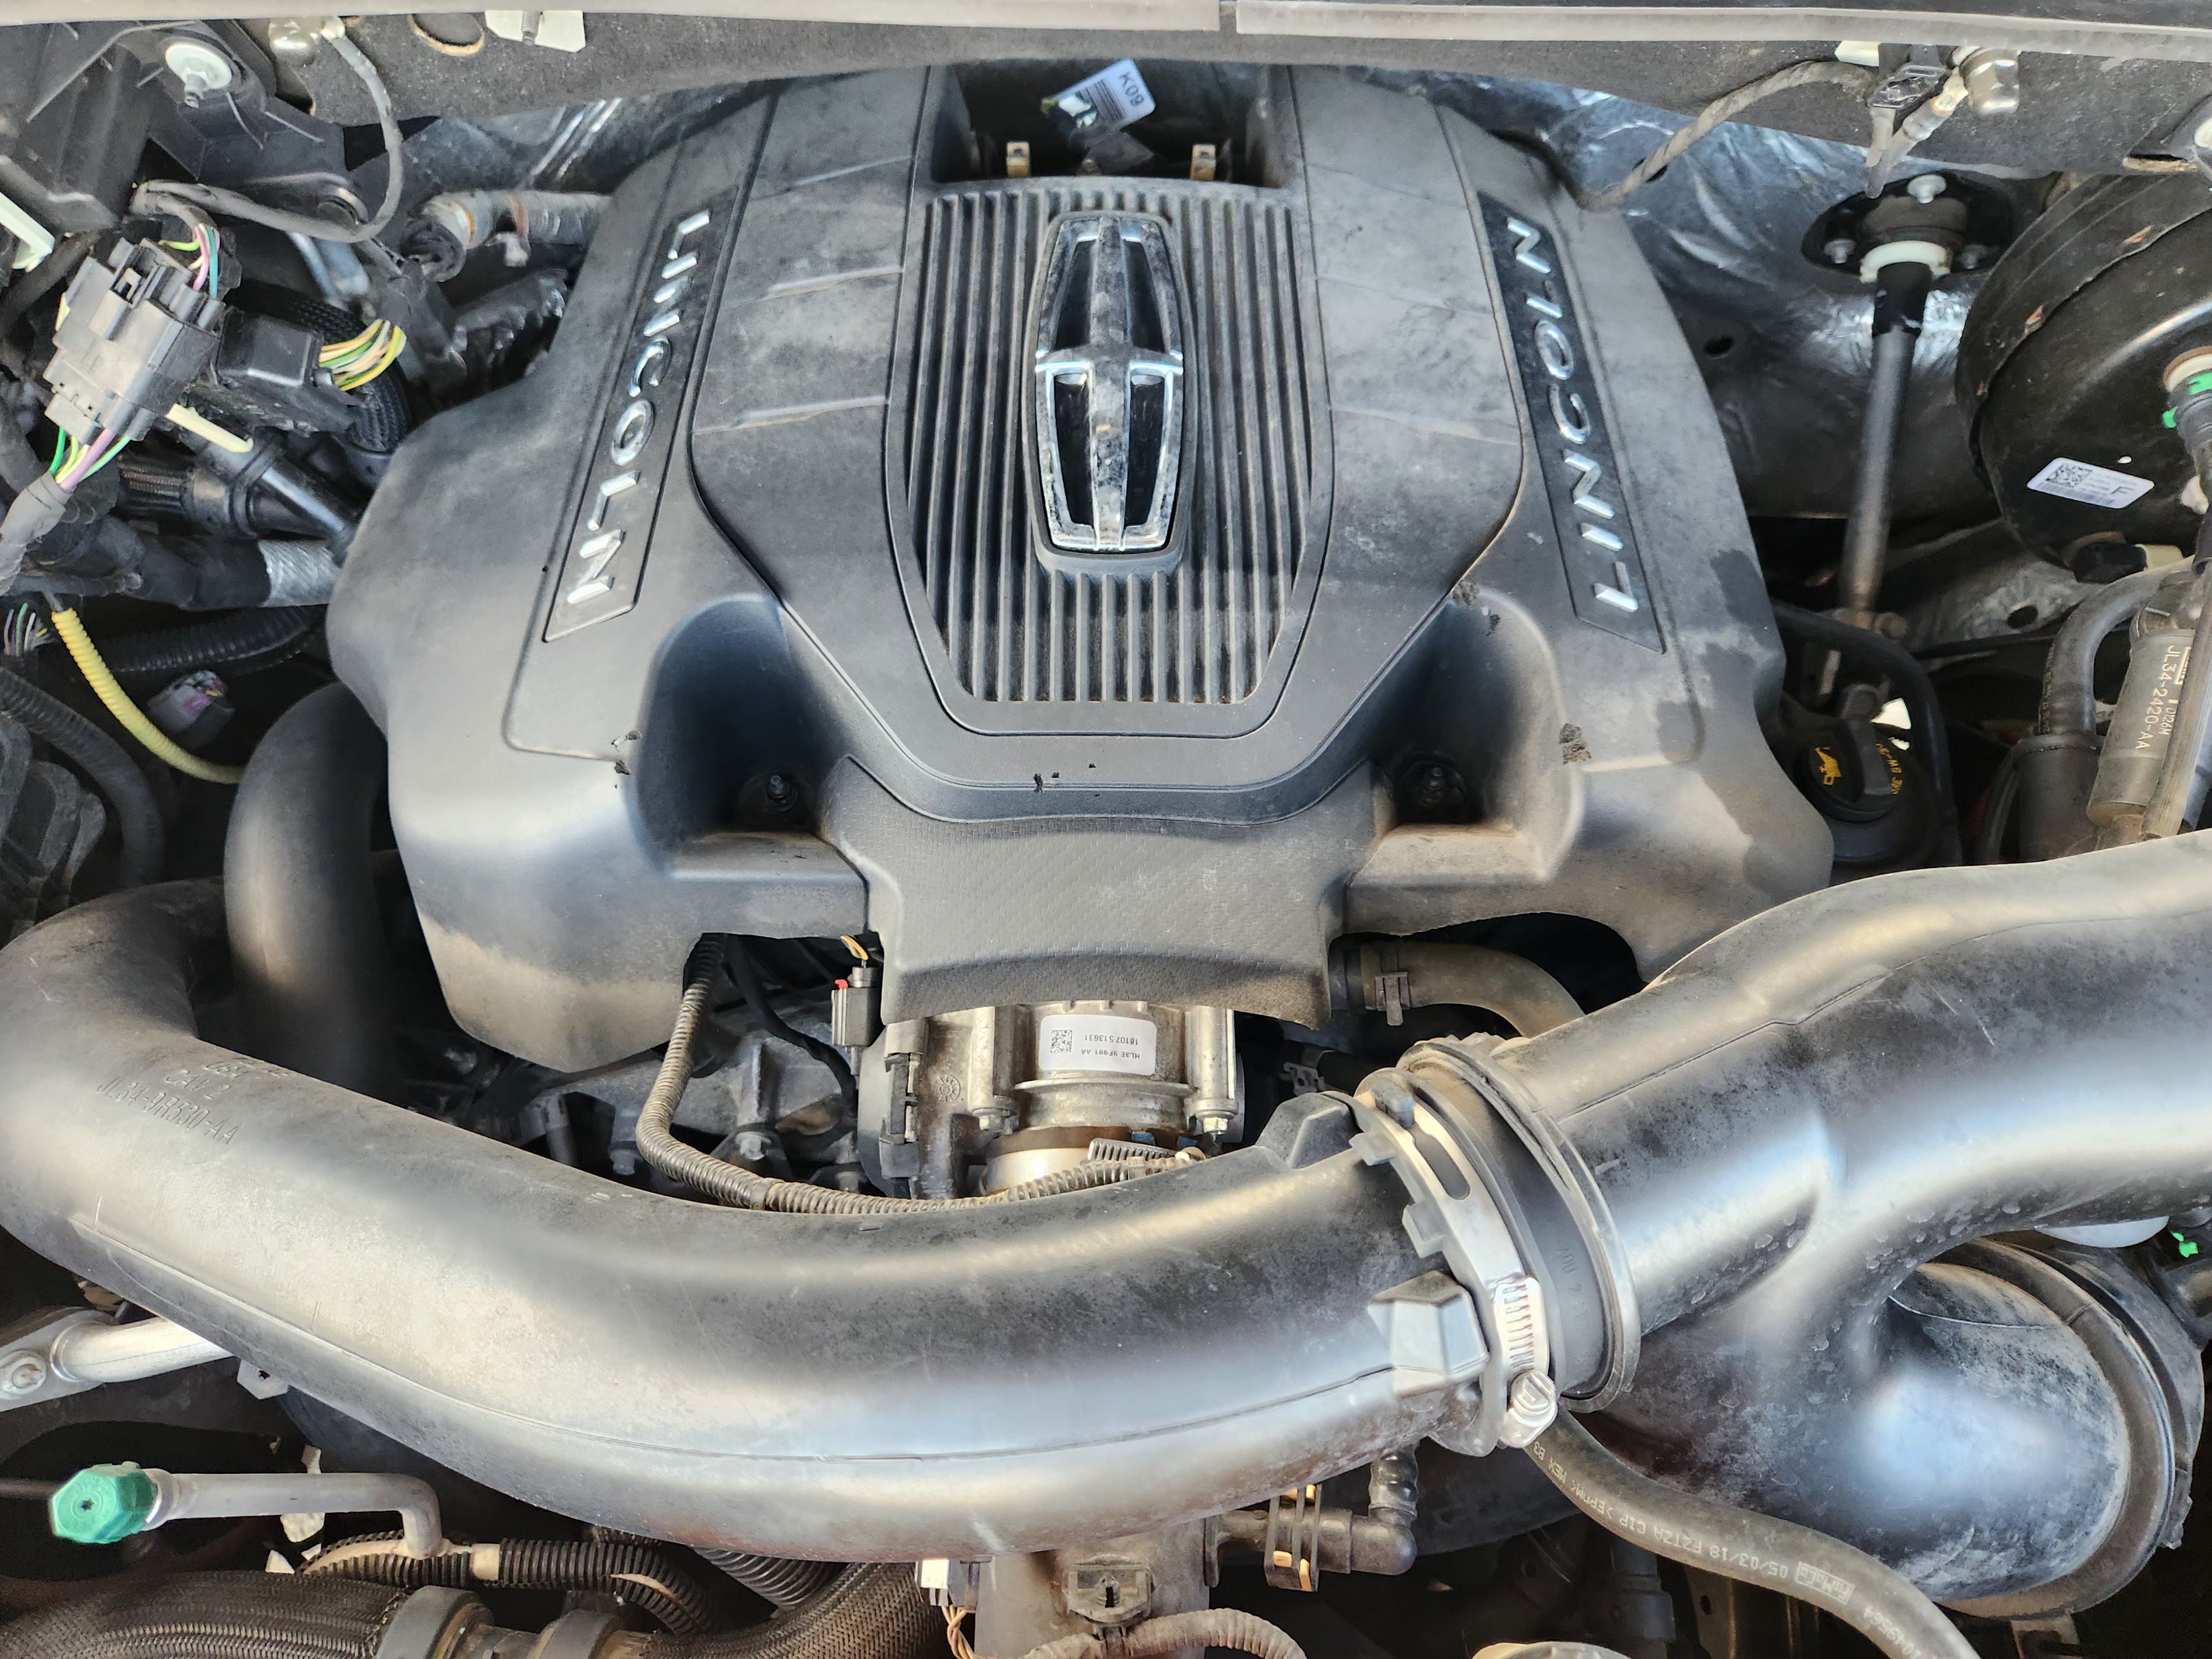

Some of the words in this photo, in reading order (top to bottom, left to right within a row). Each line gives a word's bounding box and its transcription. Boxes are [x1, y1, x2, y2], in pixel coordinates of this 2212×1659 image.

[565, 209, 710, 606] LINCOLN
[1506, 217, 1640, 613] LINCOLN
[2135, 645, 2182, 749] JL34-2420-AA
[1094, 1048, 1118, 1057] 9F991
[165, 1070, 211, 1091] CAV
[1619, 1514, 1646, 1534] CIP
[1709, 1545, 1789, 1579] 05/03/18
